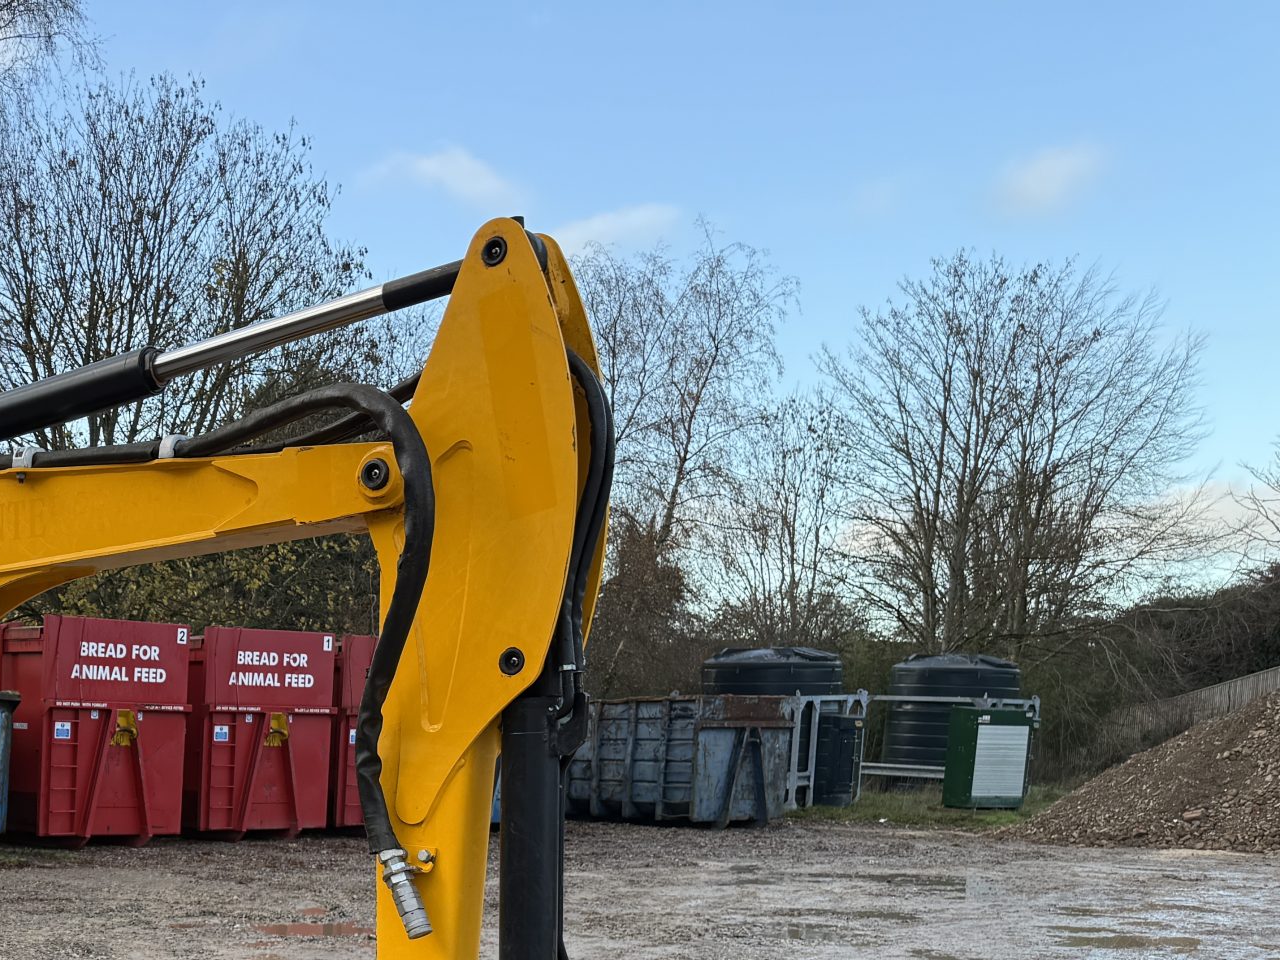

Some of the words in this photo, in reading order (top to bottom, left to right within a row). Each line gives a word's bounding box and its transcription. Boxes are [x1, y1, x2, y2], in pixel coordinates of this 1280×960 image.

[178, 630, 185, 642] 2
[80, 641, 127, 659] BREAD
[131, 644, 160, 661] FOR
[237, 650, 279, 666] BREAD
[283, 653, 308, 667] FOR
[70, 663, 129, 682] ANIMAL
[133, 667, 167, 683] FEED
[228, 671, 281, 687] ANIMAL
[284, 674, 315, 688] FEED
